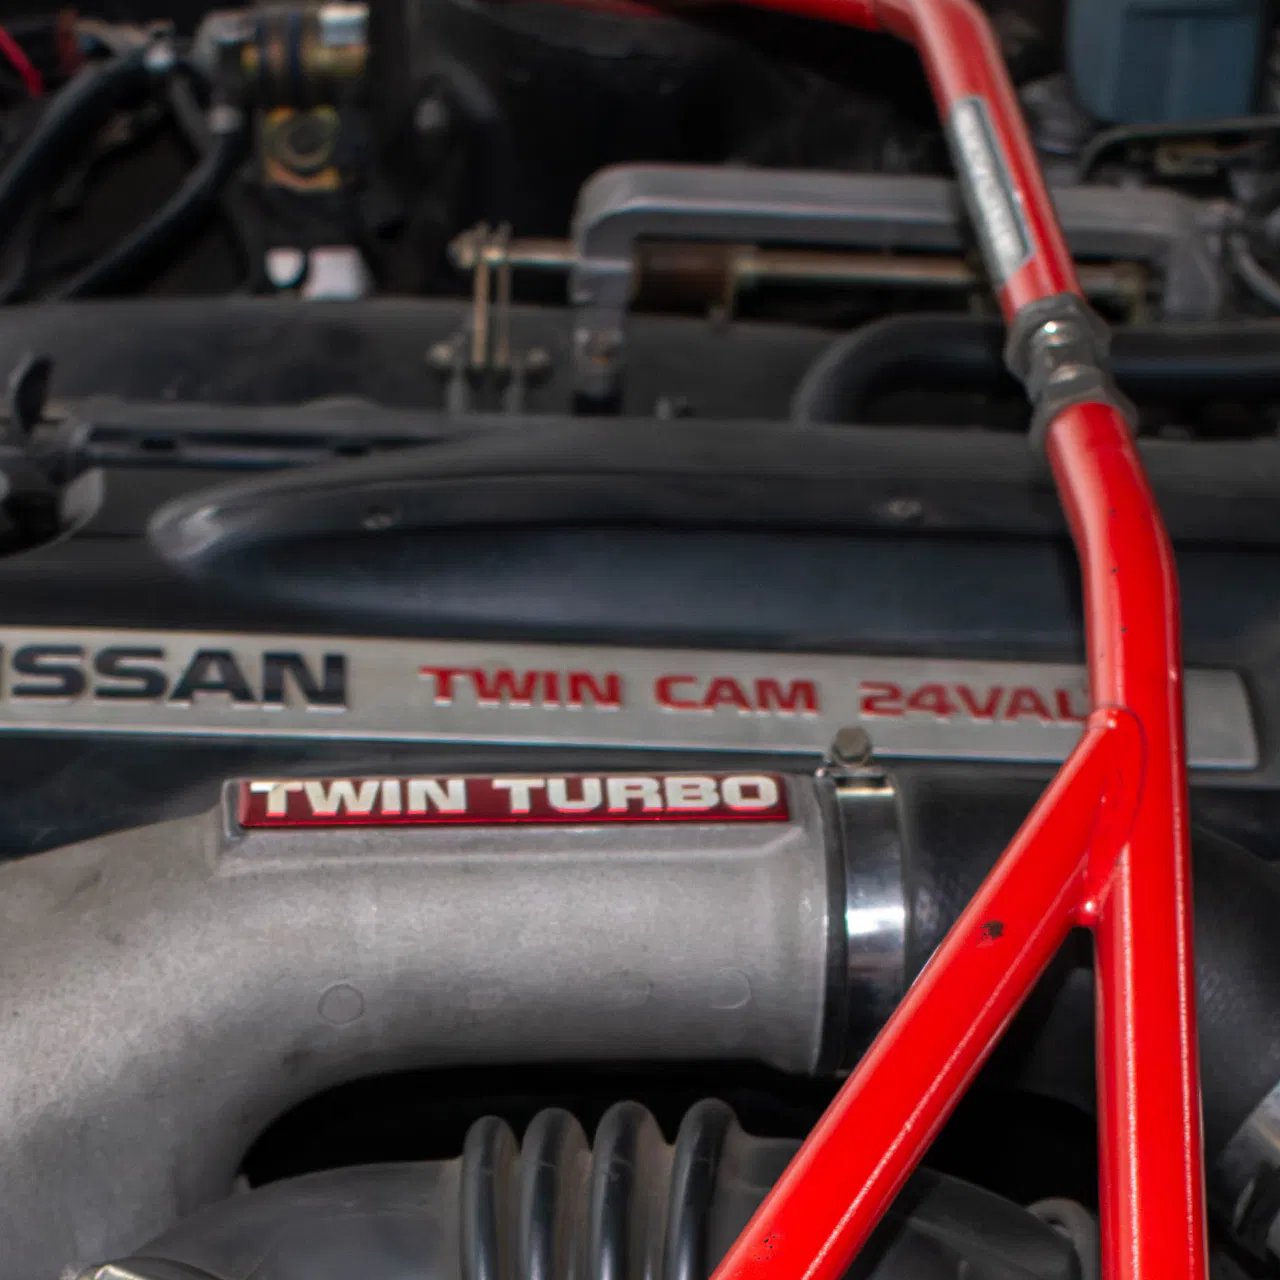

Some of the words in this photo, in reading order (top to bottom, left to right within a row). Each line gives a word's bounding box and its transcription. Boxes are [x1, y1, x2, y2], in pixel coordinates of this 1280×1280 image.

[419, 666, 624, 709] TWIN
[654, 674, 820, 714] CAM
[858, 680, 1088, 720] 24VAL
[249, 776, 469, 818] TWIN
[492, 774, 780, 816] TURBO
